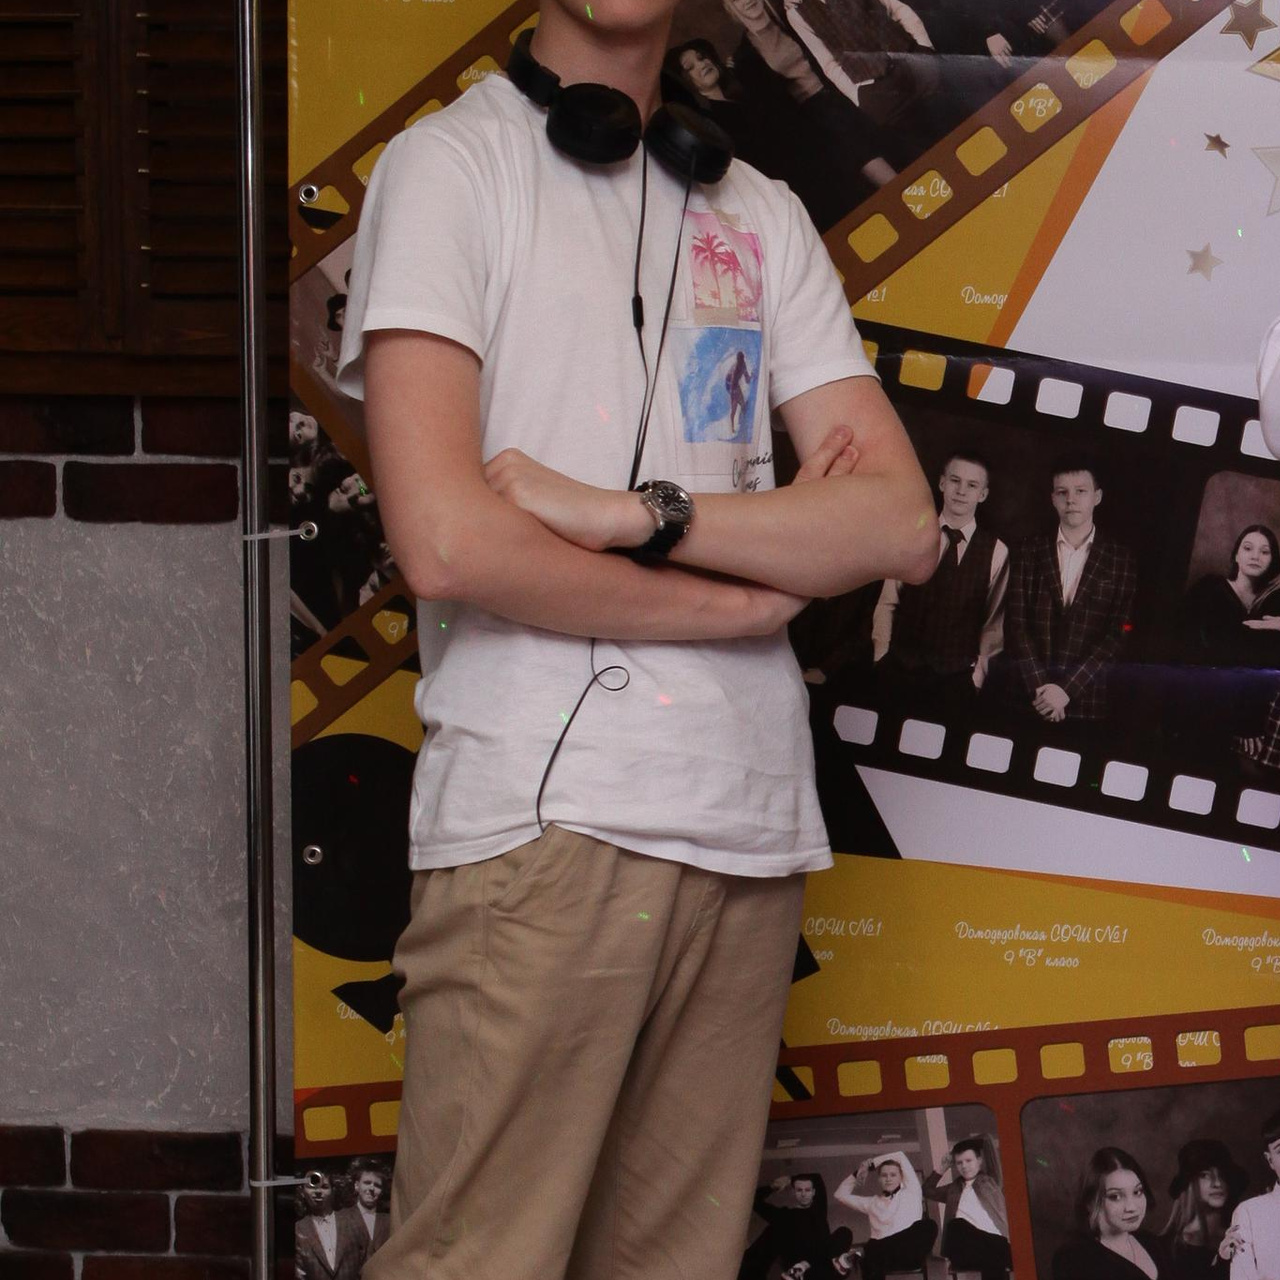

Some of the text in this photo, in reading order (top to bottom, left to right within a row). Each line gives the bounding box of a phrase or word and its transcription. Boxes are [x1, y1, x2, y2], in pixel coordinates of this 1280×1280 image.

[805, 917, 883, 937] СОШ №1
[1051, 923, 1093, 943] СОШ
[1096, 924, 1128, 944] №1
[1004, 951, 1015, 966] 9
[1251, 957, 1262, 972] 9
